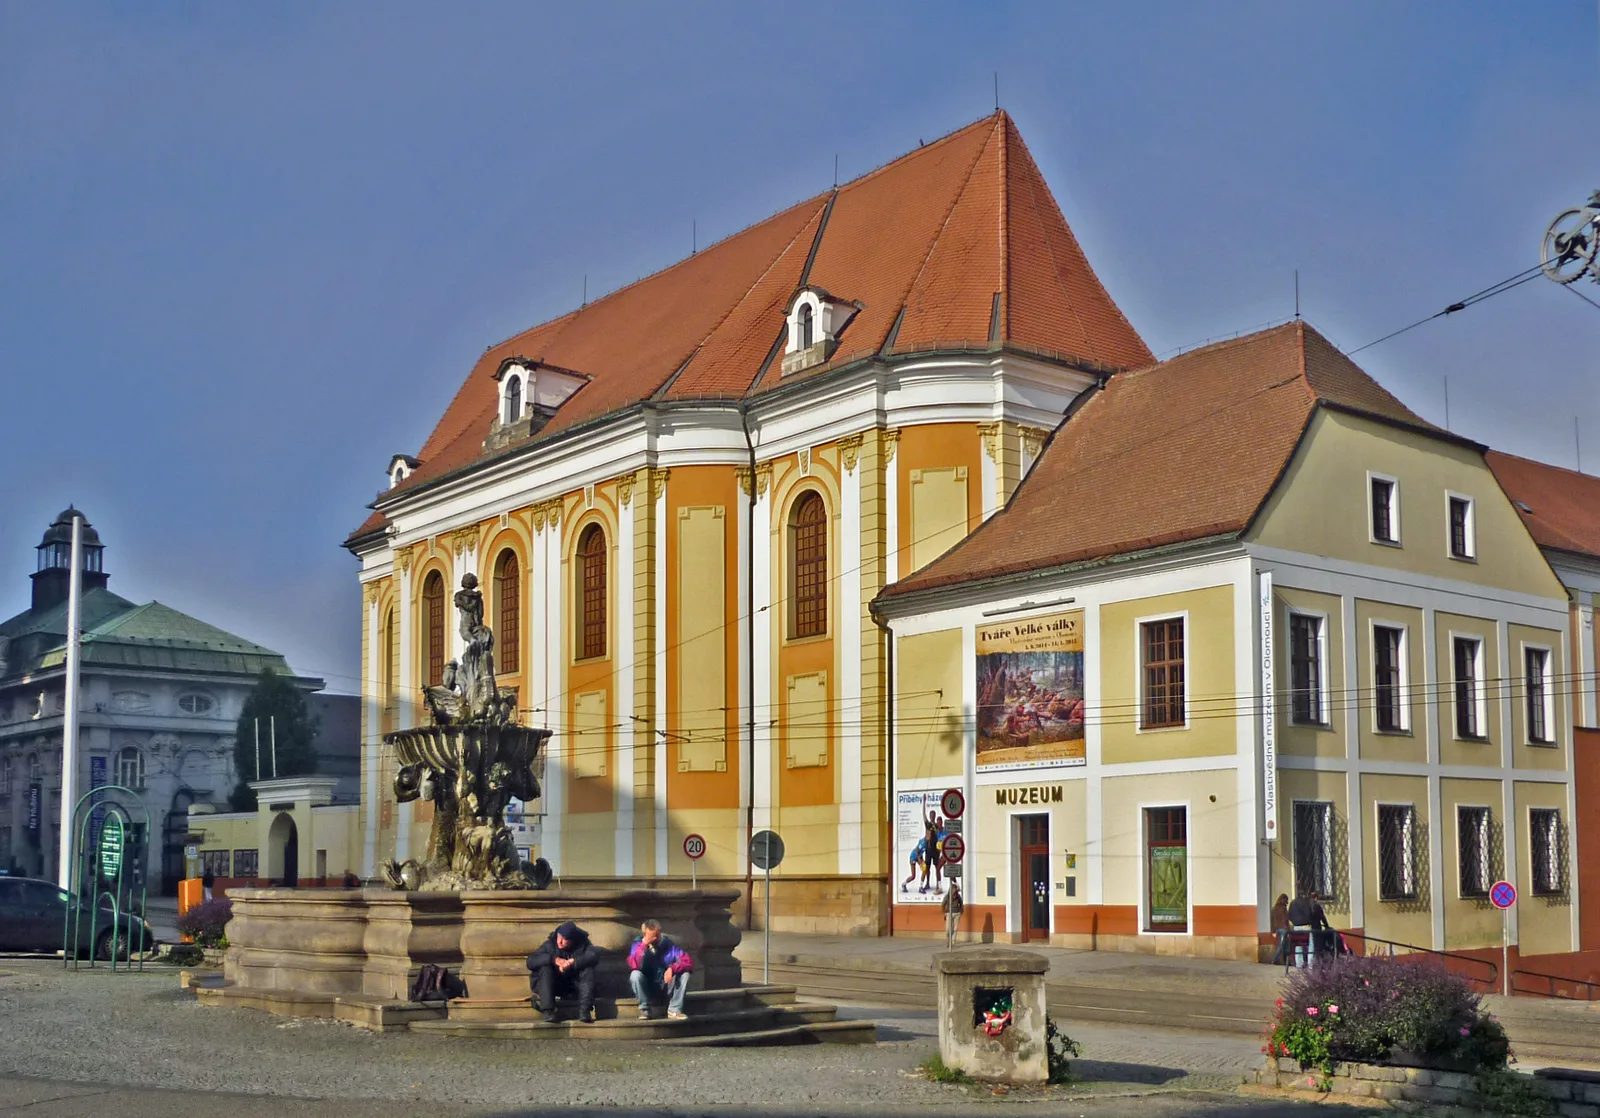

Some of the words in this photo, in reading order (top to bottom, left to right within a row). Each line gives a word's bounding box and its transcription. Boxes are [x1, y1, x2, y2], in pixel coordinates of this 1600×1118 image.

[980, 628, 1011, 642] Tváře
[1014, 622, 1043, 636] Velké
[1046, 618, 1077, 631] války
[1263, 611, 1272, 669] Olomouci
[1265, 672, 1272, 680] v
[1265, 683, 1274, 736] muzeum
[1265, 739, 1275, 811] Vlastivědné
[899, 793, 922, 804] Příběhy
[995, 785, 1063, 806] MUZEUM
[688, 840, 702, 853] 20
